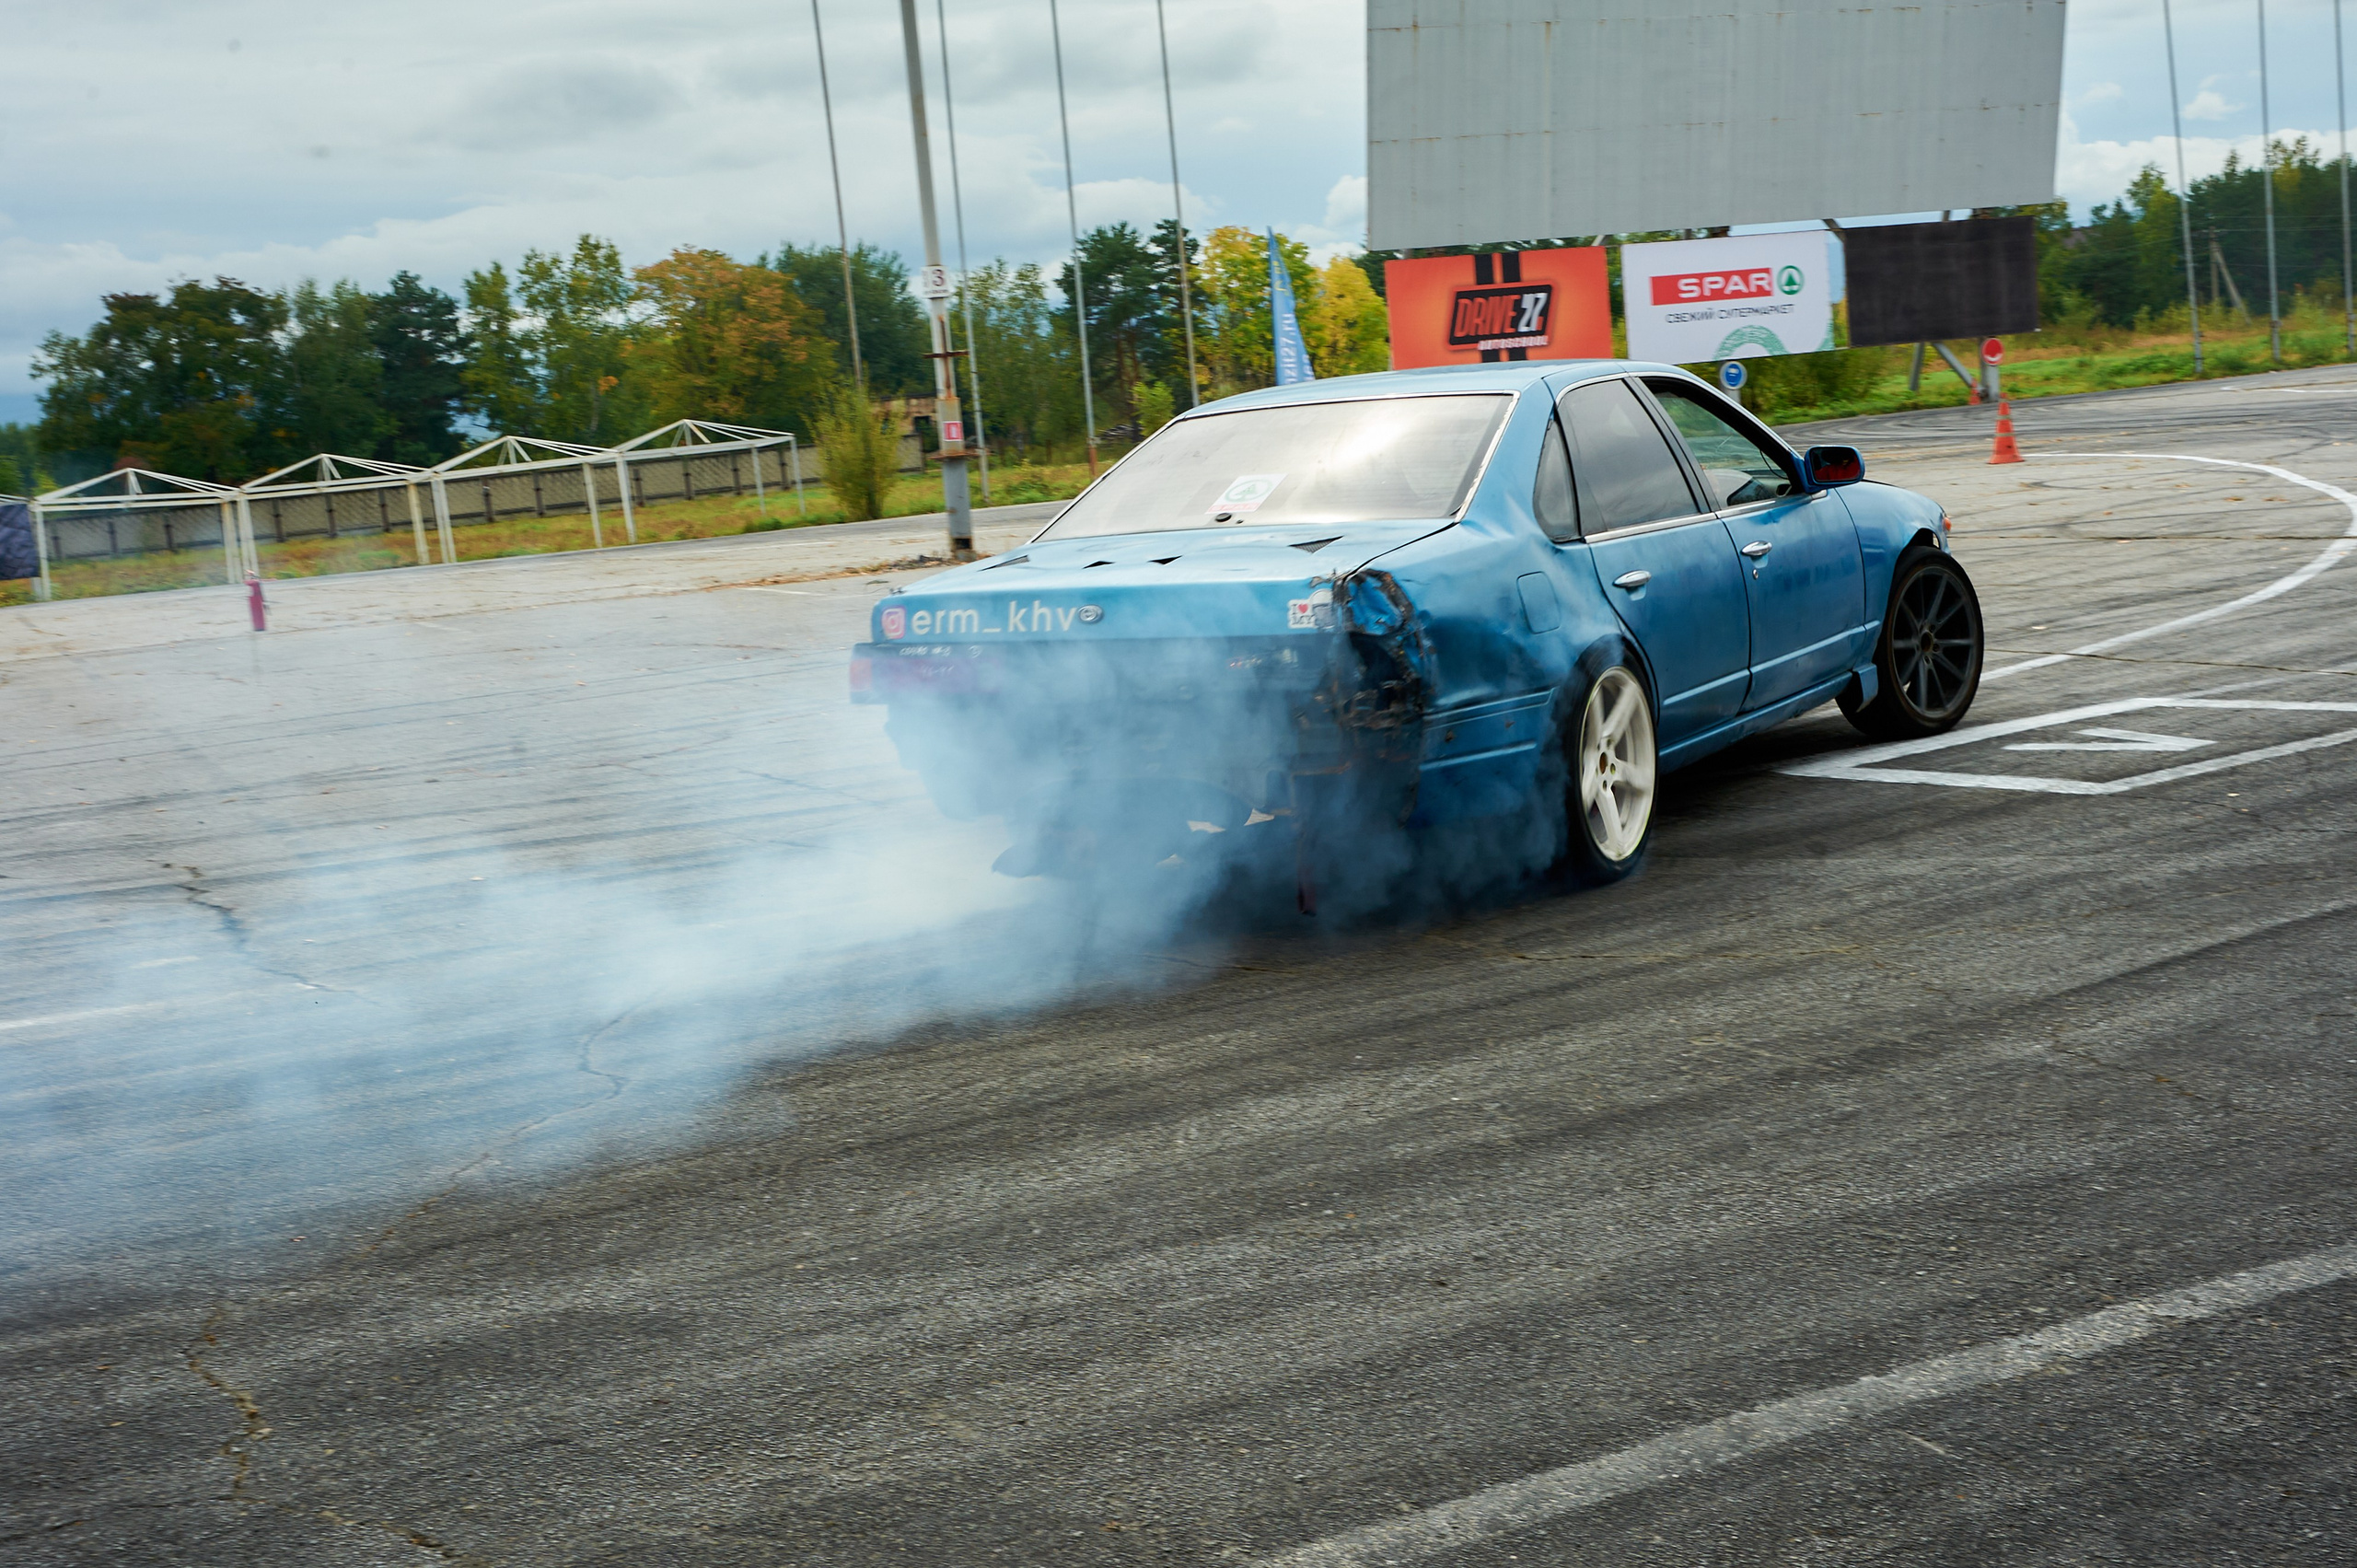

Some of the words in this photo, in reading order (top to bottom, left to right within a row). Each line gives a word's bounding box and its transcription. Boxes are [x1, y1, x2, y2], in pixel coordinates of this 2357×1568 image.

[1678, 273, 1772, 298] SPAR
[1454, 295, 1521, 338] DRIVE
[1665, 308, 1715, 323] СВЕЖИЙ
[1717, 304, 1794, 319] СУПЕРМАРКЕТ
[911, 600, 1077, 635] erm_khv
